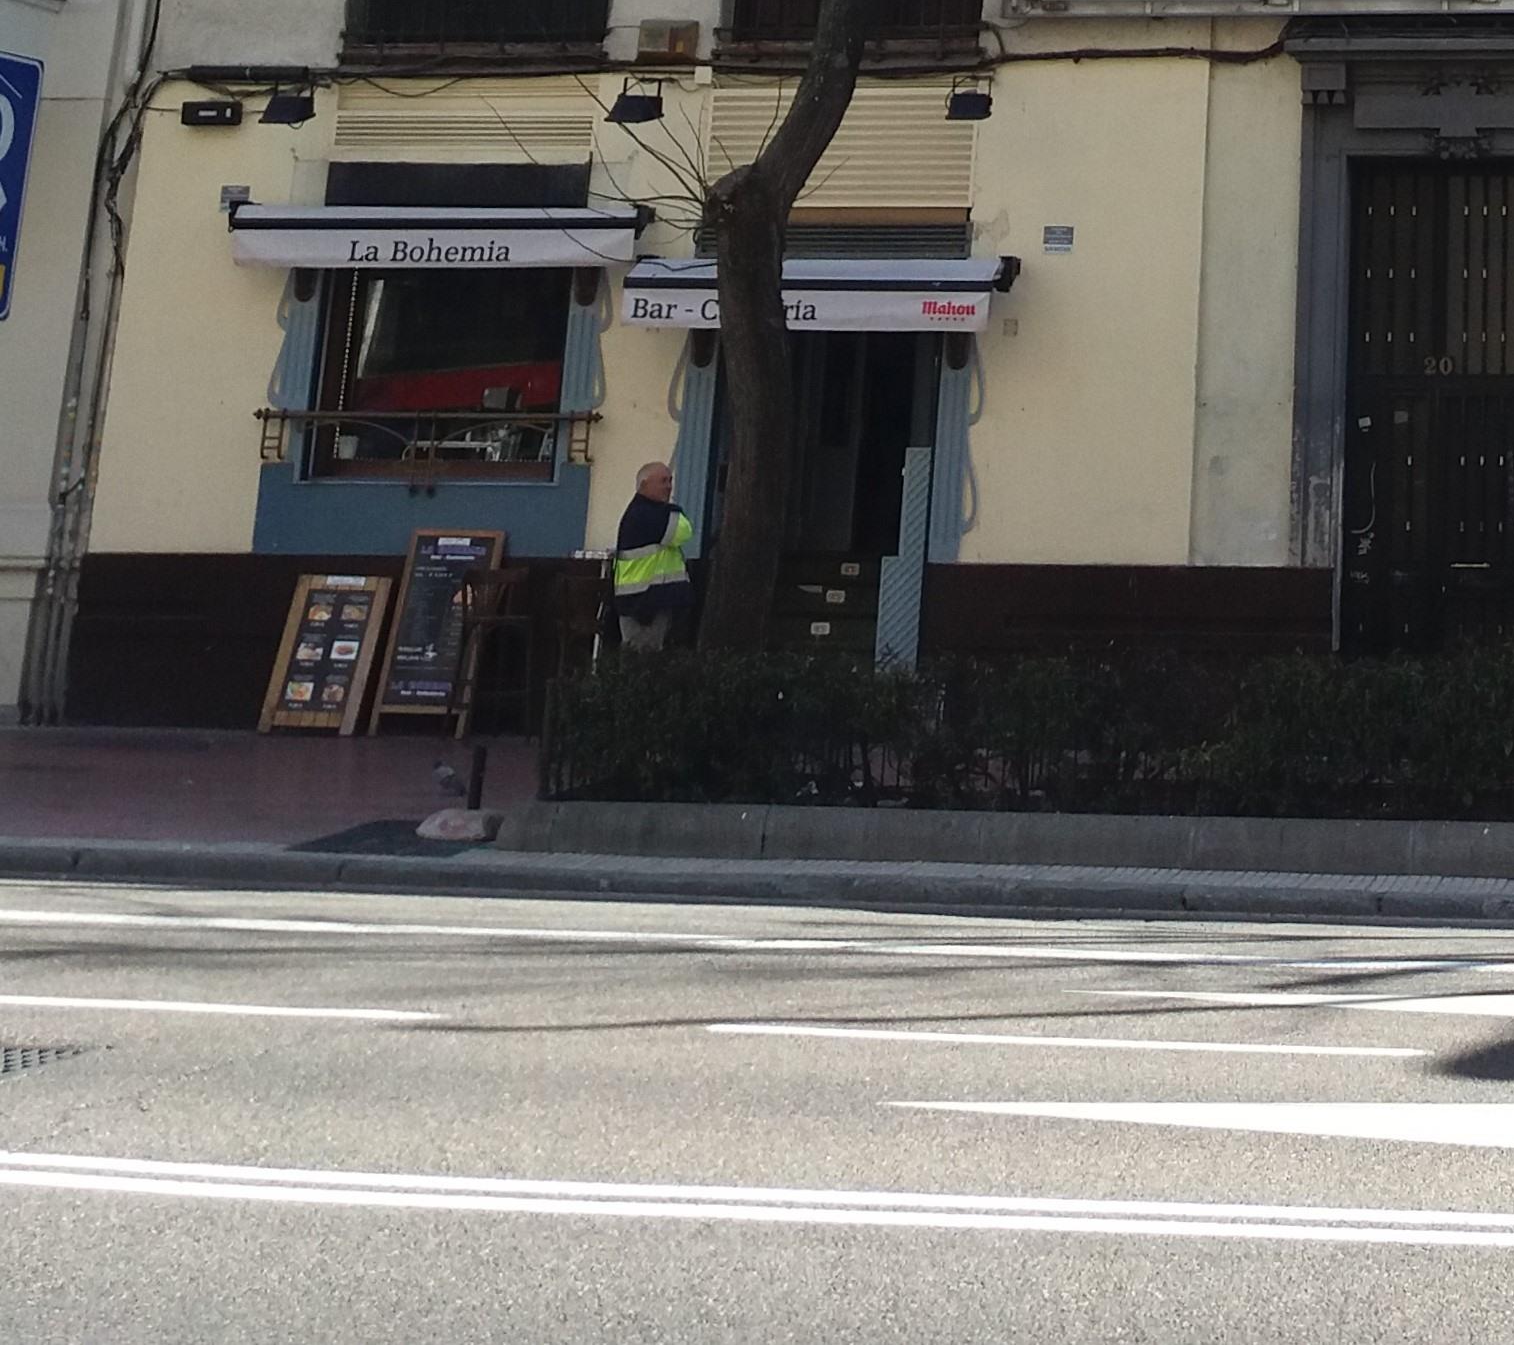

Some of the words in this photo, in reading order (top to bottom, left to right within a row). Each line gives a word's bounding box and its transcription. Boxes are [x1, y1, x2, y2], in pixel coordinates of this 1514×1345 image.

[347, 240, 379, 262] La
[390, 237, 511, 262] Bohemia
[631, 297, 677, 320] Bar
[922, 300, 976, 316] Mahou
[1423, 356, 1453, 376] 20
